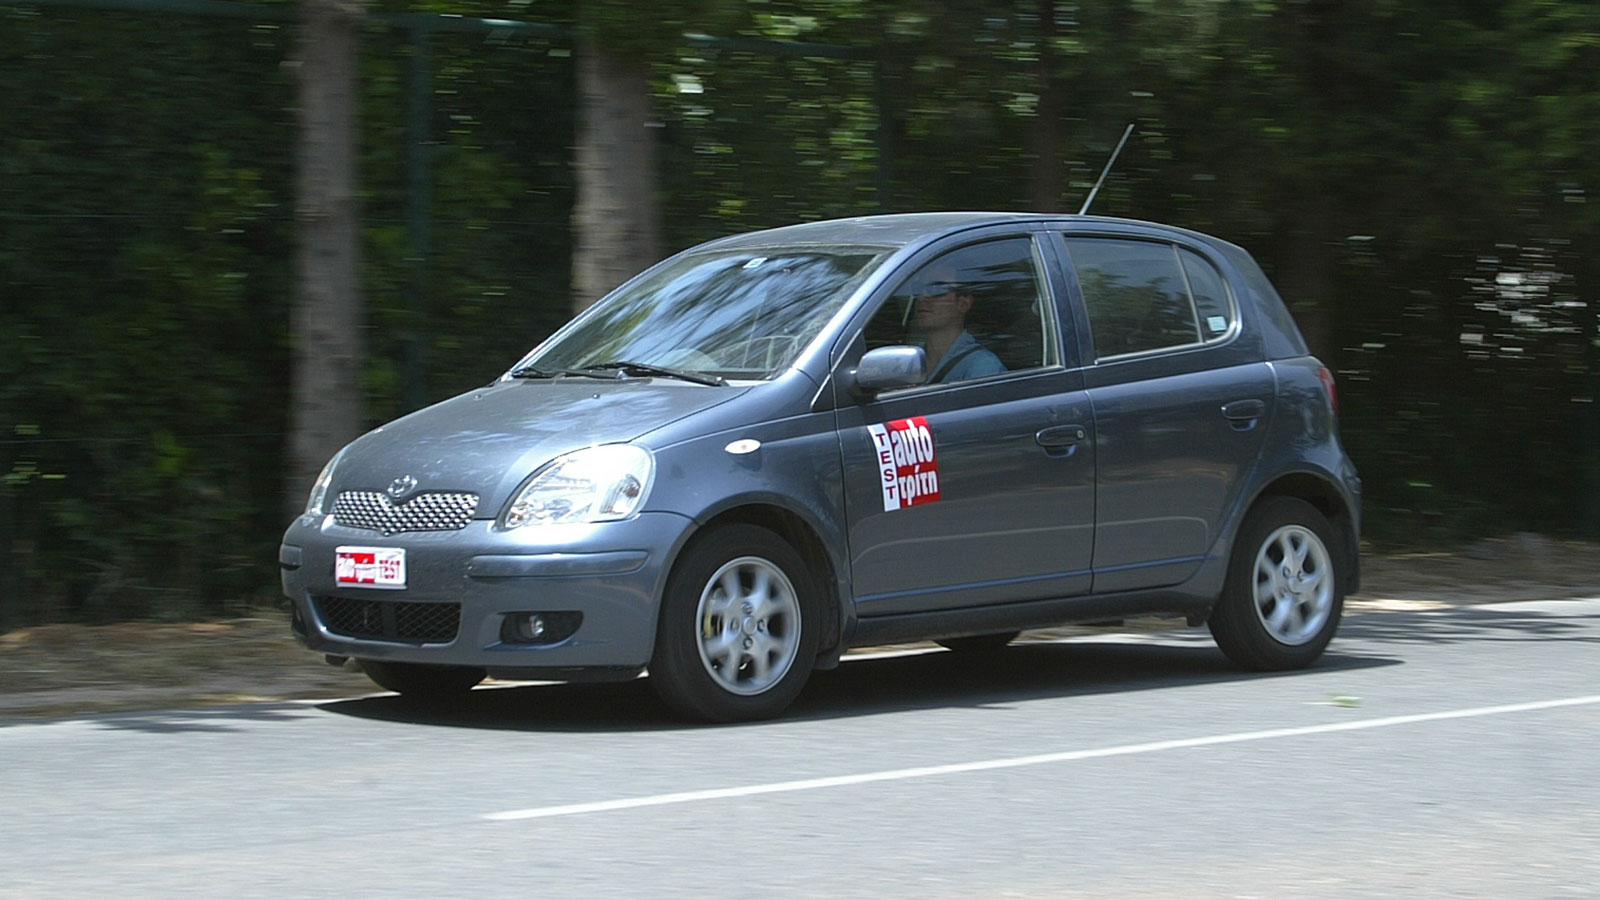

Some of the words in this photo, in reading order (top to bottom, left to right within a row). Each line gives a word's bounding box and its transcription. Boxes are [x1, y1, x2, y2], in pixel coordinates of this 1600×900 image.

[875, 433, 896, 499] TEST
[891, 419, 933, 468] auto
[898, 464, 938, 506] τρίτη
